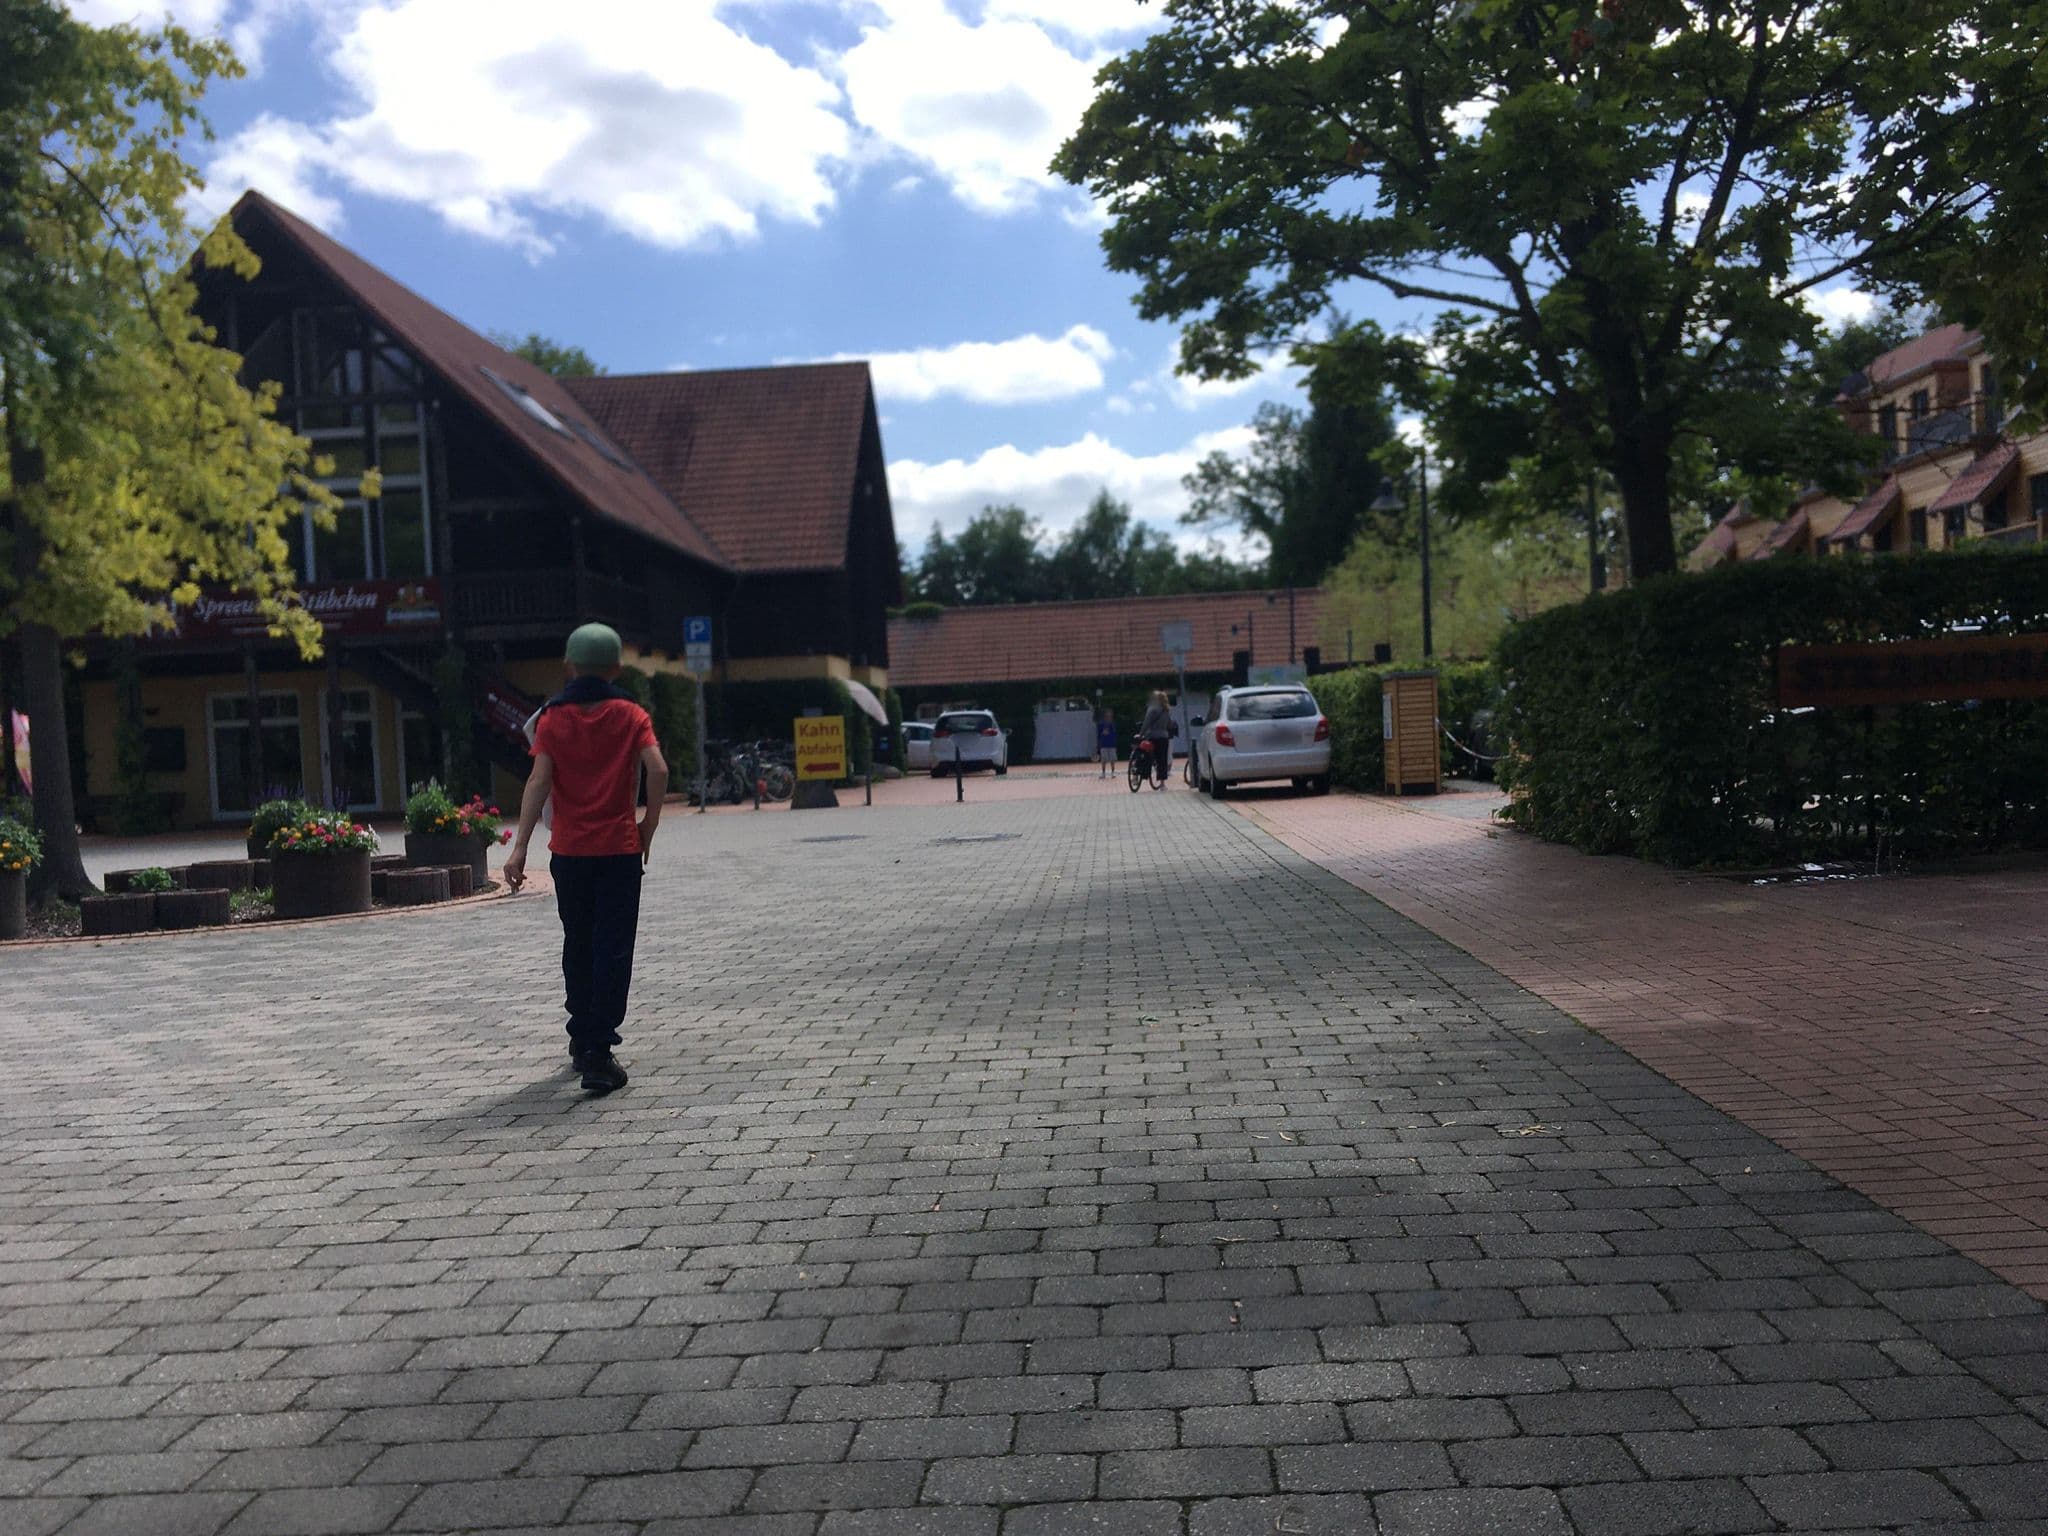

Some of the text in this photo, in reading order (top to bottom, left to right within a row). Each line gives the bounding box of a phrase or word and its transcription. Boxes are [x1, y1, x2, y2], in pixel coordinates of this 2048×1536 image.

[298, 586, 379, 610] Stübchen
[689, 619, 705, 640] P
[799, 722, 840, 737] Kahn
[798, 742, 843, 755] Abfahrt
